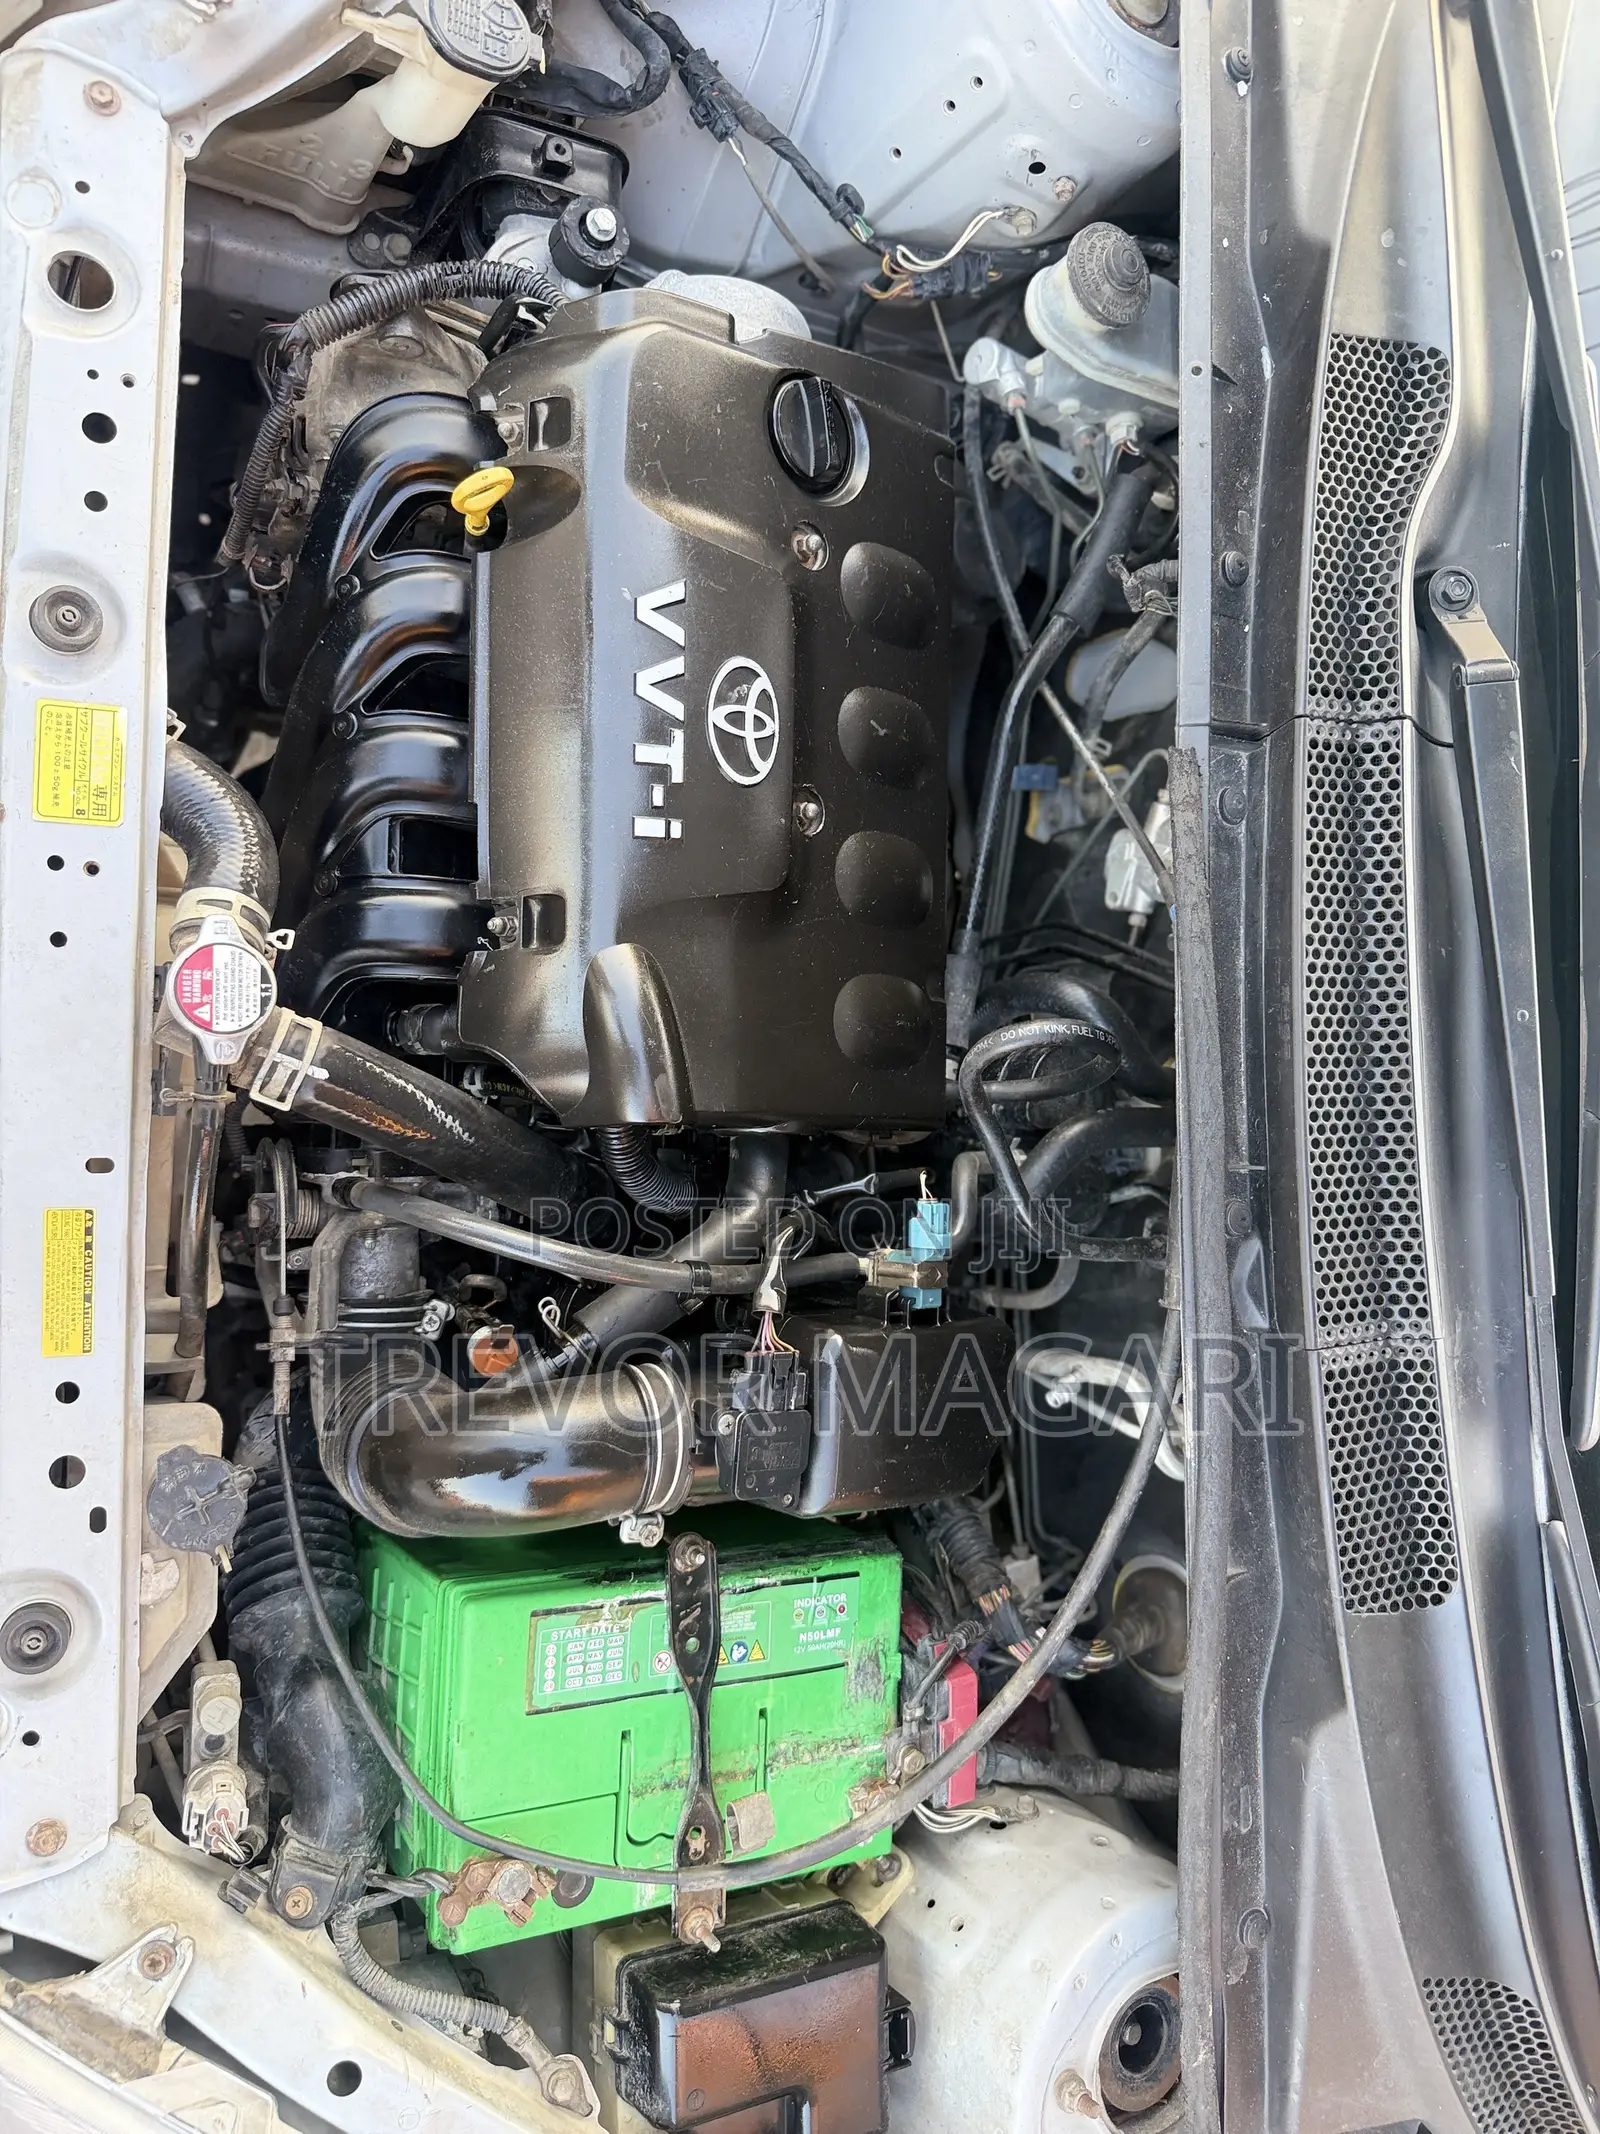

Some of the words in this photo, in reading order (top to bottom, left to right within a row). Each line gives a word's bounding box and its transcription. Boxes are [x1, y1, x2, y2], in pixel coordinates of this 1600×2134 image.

[632, 578, 687, 841] VVT-i
[91, 785, 108, 817] 専用
[182, 969, 192, 1004] DANGER
[1000, 1030, 1016, 1041] DO
[1018, 1025, 1040, 1039] NOT
[1071, 1025, 1094, 1038] FUEL
[84, 1250, 93, 1295] CAUTION
[83, 1301, 92, 1351] ATTENTION
[793, 1592, 847, 1609] INDICATOR
[551, 1626, 588, 1641] START
[591, 1623, 620, 1636] DATE
[799, 1627, 841, 1643] N50LMF
[607, 1672, 621, 1680] DEC
